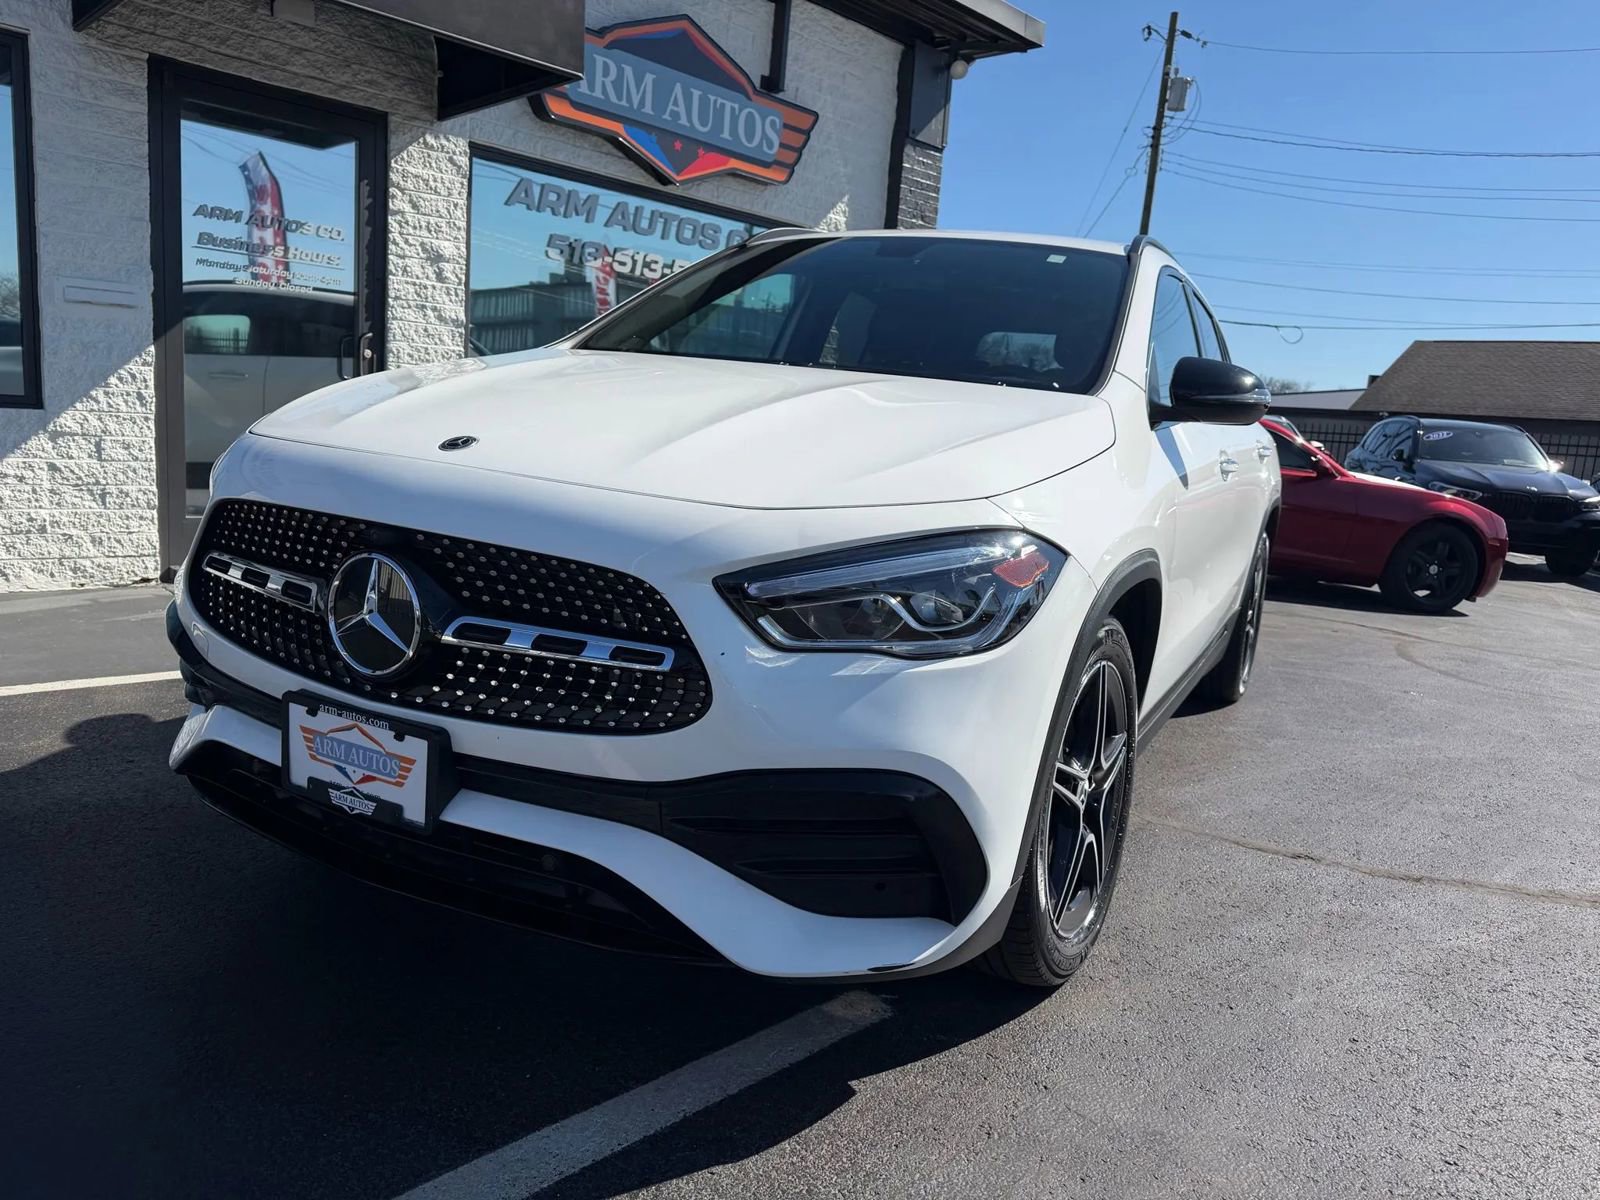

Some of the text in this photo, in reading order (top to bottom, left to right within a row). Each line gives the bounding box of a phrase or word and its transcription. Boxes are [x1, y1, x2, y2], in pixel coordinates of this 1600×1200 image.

[662, 82, 781, 155] AUTOS
[192, 204, 244, 223] ARM
[245, 213, 312, 236] AUTOS
[503, 177, 599, 224] ARM
[604, 201, 723, 251] AUTOS
[197, 231, 285, 258] Business
[319, 703, 390, 731] arm-autos.com
[314, 735, 401, 777] ARM AUTOS
[349, 798, 371, 810] AUTOS
